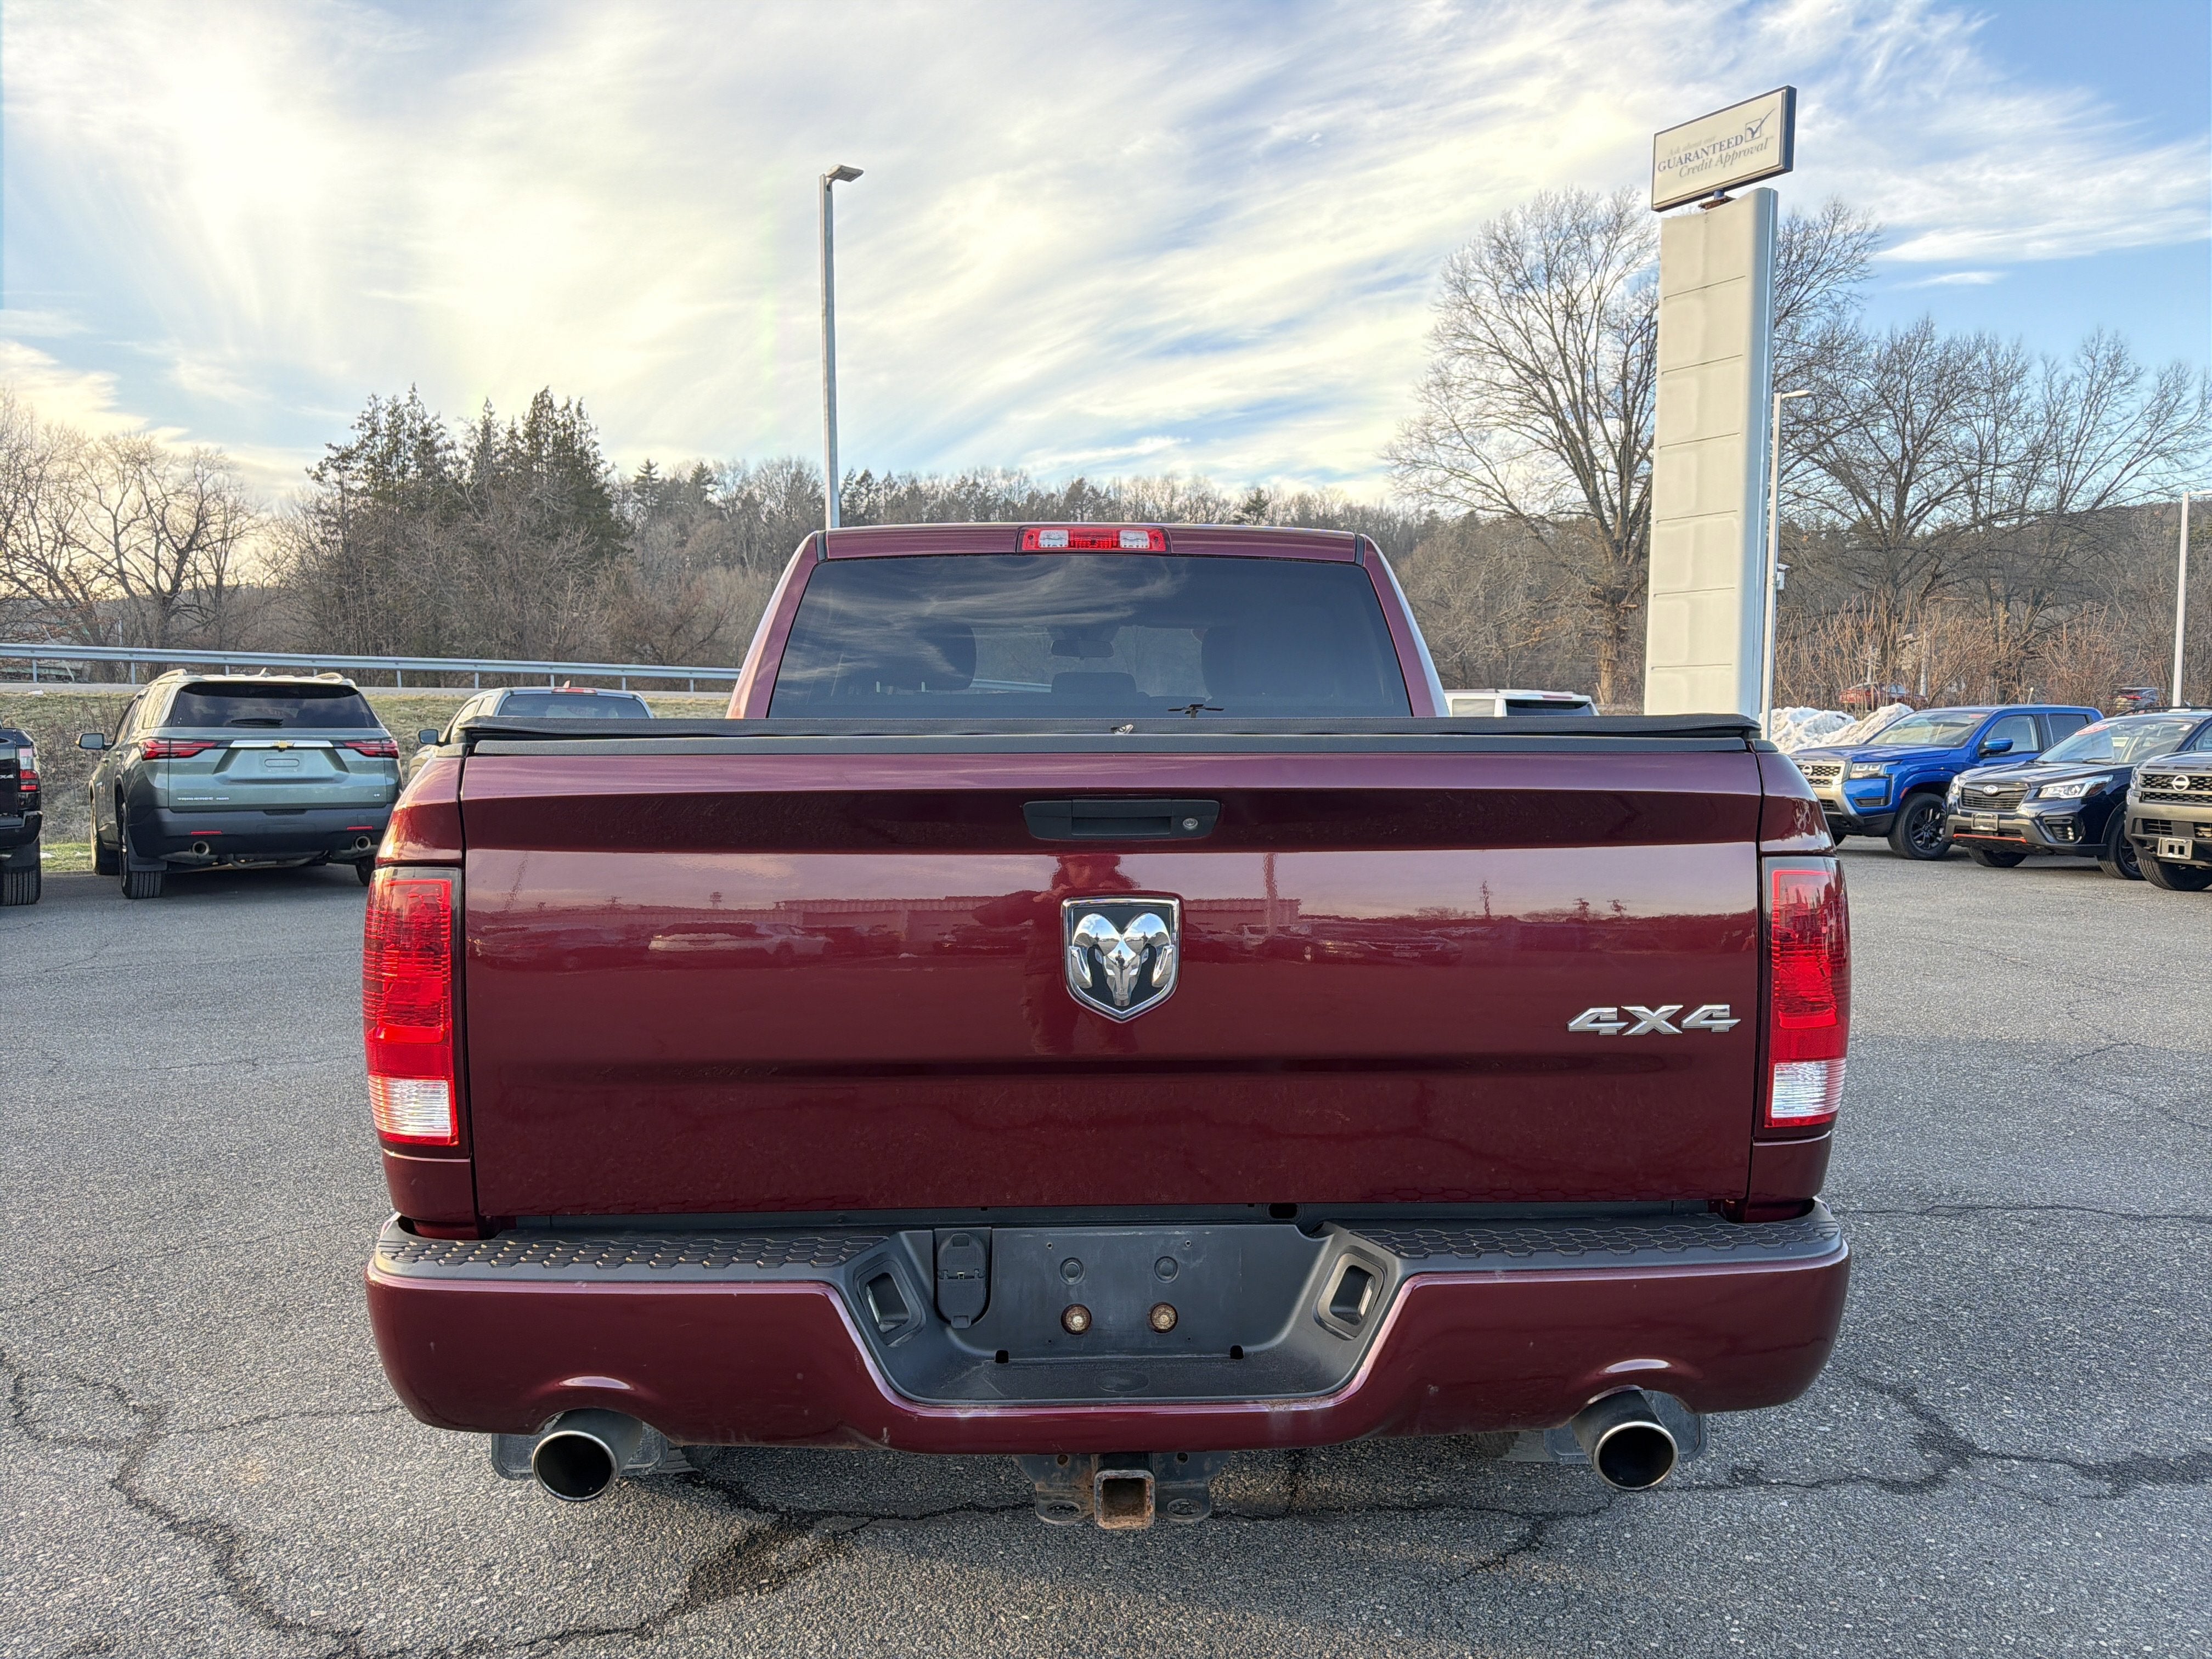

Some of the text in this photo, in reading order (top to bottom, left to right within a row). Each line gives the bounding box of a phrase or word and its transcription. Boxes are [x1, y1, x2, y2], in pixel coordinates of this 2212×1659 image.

[1657, 134, 1743, 172] GUARANTEED
[1679, 138, 1769, 178] Credit Approval
[1566, 1004, 1742, 1036] 4X4
